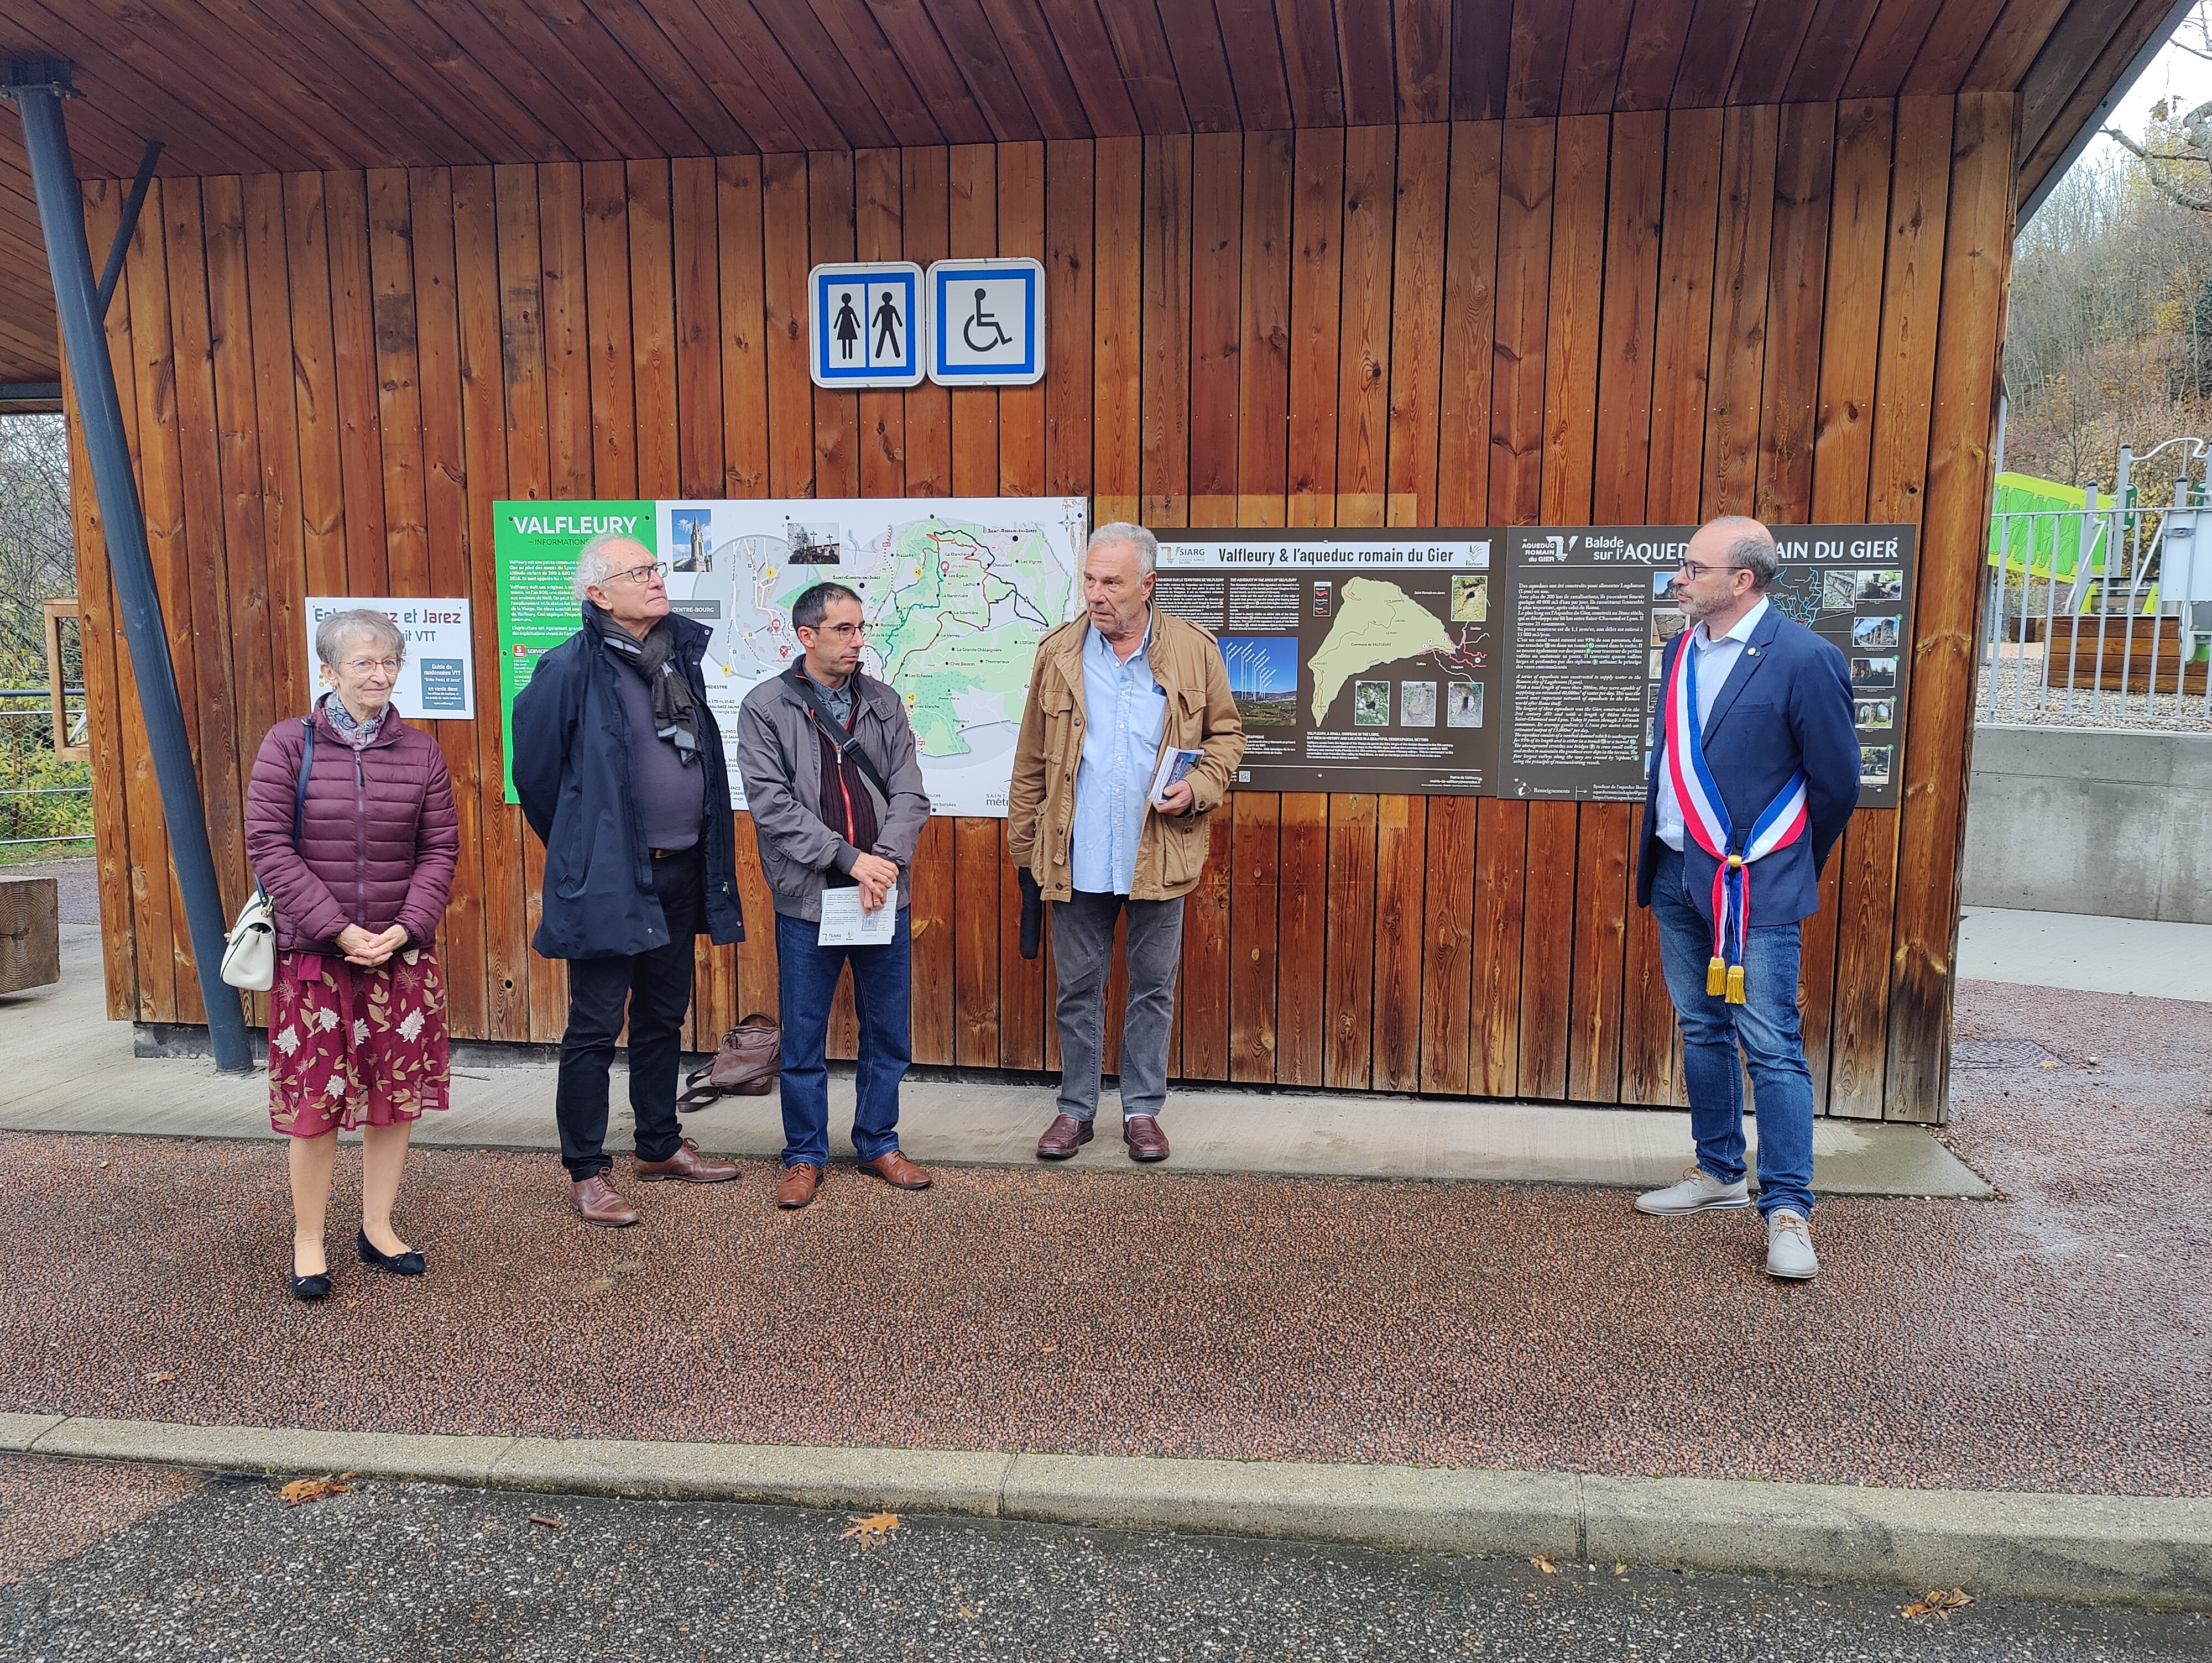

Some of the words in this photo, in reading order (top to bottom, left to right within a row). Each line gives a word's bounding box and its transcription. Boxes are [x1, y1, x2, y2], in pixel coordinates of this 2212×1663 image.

[513, 516, 637, 534] VALFLEURY
[1585, 536, 1624, 548] Balade
[1219, 548, 1275, 565] Valfleury
[1280, 548, 1288, 562] &
[1294, 548, 1353, 565] l'aqueduc
[1359, 548, 1402, 562] romain
[1408, 548, 1422, 562] du
[1428, 548, 1453, 562] Gier
[1616, 543, 1689, 564] l'AQUED
[1815, 541, 1844, 558] DU
[1850, 541, 1898, 558] GIER
[404, 609, 417, 623] et
[423, 609, 461, 623] Jarez
[415, 631, 436, 641] VTT
